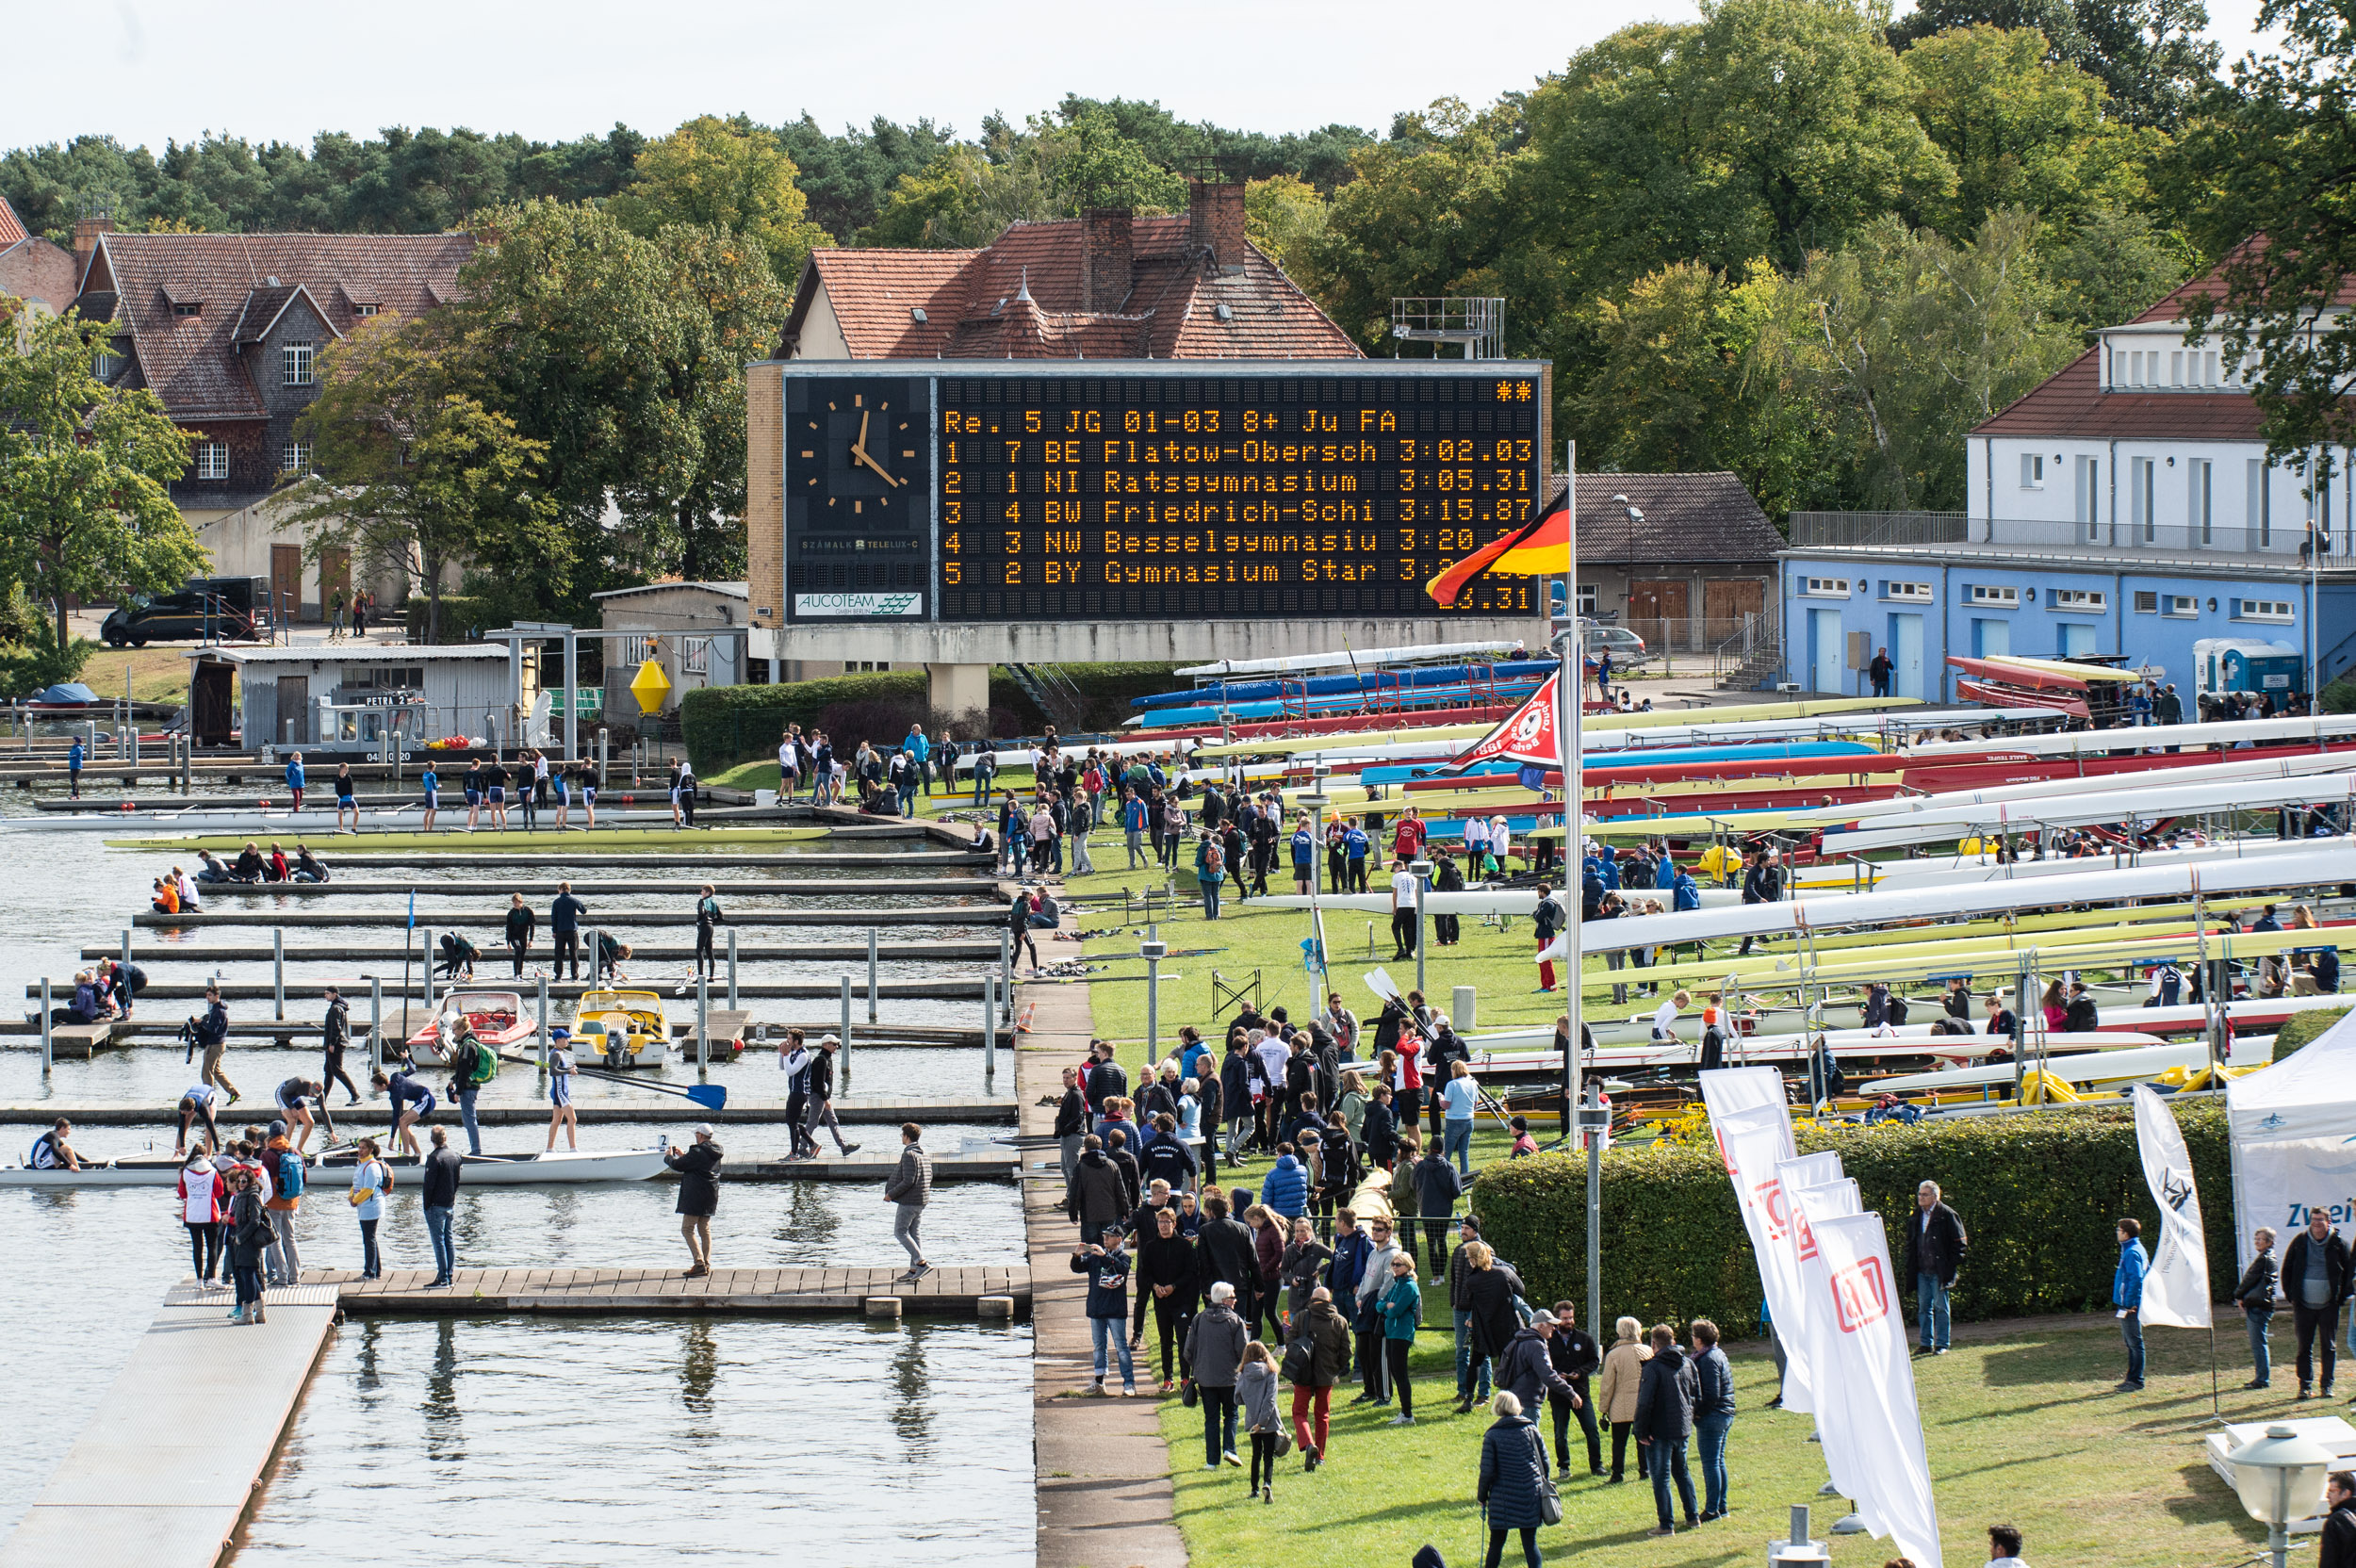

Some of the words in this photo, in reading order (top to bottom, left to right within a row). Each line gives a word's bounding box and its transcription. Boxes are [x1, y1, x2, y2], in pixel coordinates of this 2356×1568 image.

[945, 411, 999, 433] Re.
[1025, 411, 1041, 433] 5
[1065, 411, 1101, 433] JG
[1124, 411, 1219, 433] 01-03
[1243, 410, 1279, 433] 8+
[1302, 410, 1337, 433] Ju
[1360, 410, 1396, 433] FA
[946, 441, 959, 464] 1
[1005, 441, 1022, 463] 7
[1045, 440, 1081, 463] BE
[1104, 439, 1377, 463] Flatow-Obersch
[1399, 439, 1531, 462] 3:02.03
[945, 470, 961, 494] 2
[1007, 470, 1019, 493] 1
[1045, 470, 1078, 493] NI
[1104, 469, 1357, 493] Ratsgymnasium
[1399, 468, 1529, 492] 3:05.31
[945, 501, 961, 524] 3
[1006, 500, 1022, 524] 4
[1045, 500, 1081, 523] BW
[1104, 499, 1373, 523] Friedrich-Schi
[1399, 498, 1531, 521] 3:15.87
[867, 540, 919, 548] TELELUX-C
[945, 531, 961, 554] 4
[1005, 531, 1022, 554] 3
[1045, 531, 1081, 553] NW
[1104, 530, 1377, 553] Besselgymnasiu
[1399, 528, 1522, 551] 3:20.
[945, 562, 961, 584] 5
[1005, 561, 1022, 584] 2
[1045, 561, 1081, 583] BY
[1104, 560, 1279, 583] Gymnasium
[1302, 559, 1377, 582] Star
[798, 595, 875, 608] AUCOTEAM
[367, 696, 394, 706] PETRA
[399, 695, 405, 705] 2
[216, 969, 221, 978] 6
[661, 1134, 667, 1146] 2
[2286, 1197, 2352, 1228] Zei
